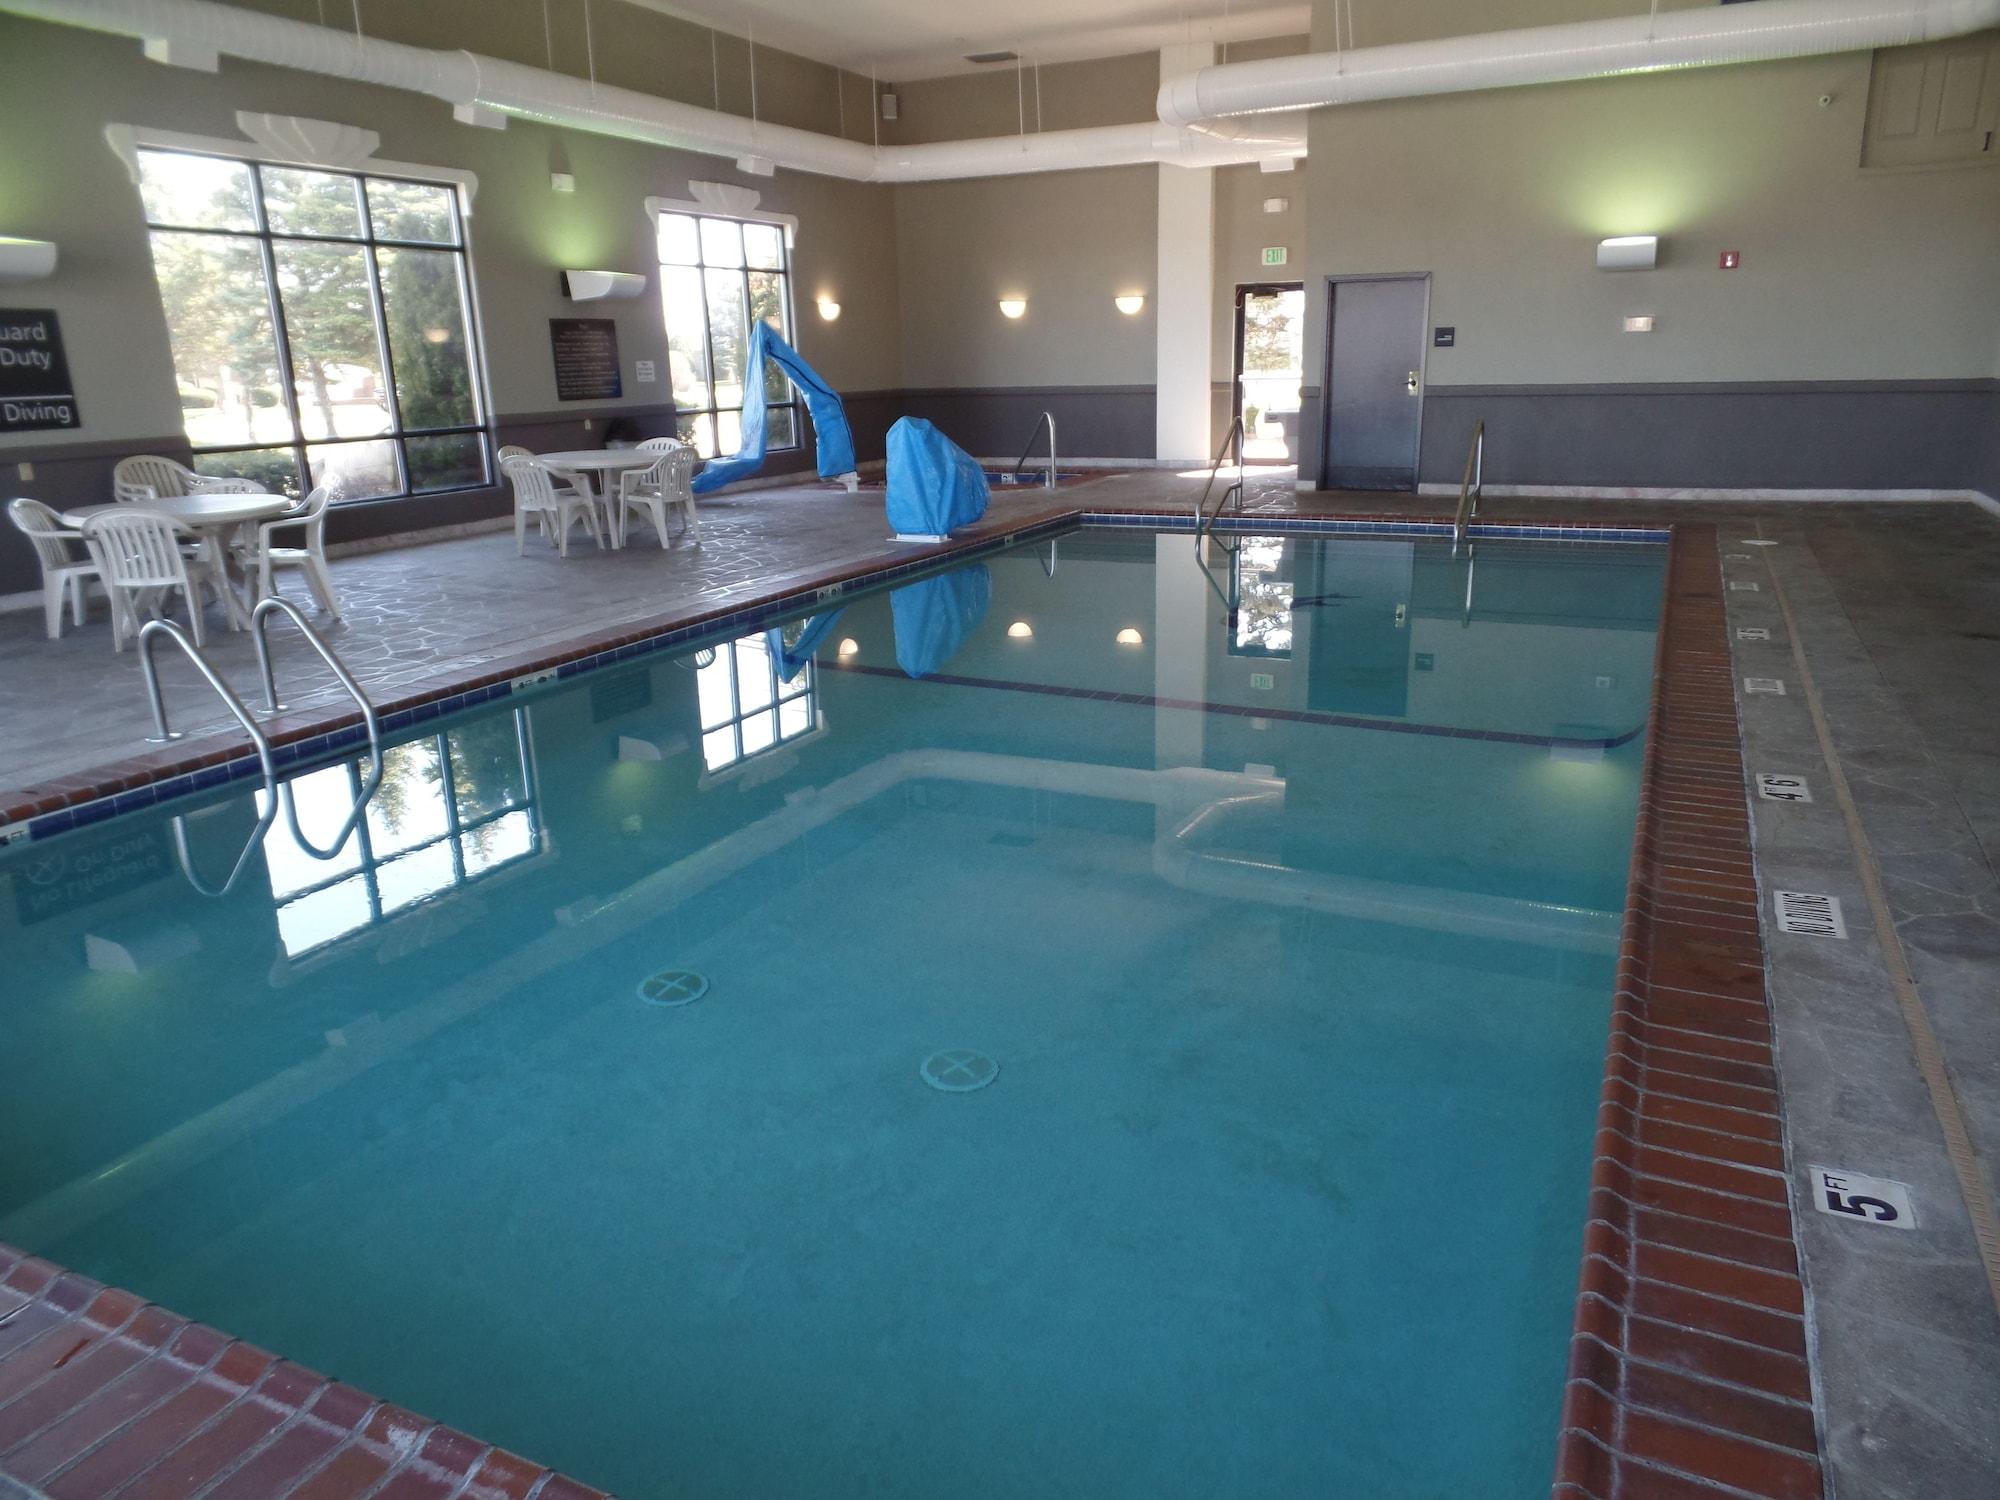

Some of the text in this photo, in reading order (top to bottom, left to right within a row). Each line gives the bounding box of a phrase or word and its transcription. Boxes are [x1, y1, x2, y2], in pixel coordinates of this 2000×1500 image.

[1266, 249, 1283, 264] EXIT
[0, 347, 50, 370] Duty
[4, 402, 71, 424] Diving
[1765, 792, 1803, 801] 4
[1782, 893, 1838, 937] NO DIVING
[1822, 1173, 1898, 1221] 5 FT
